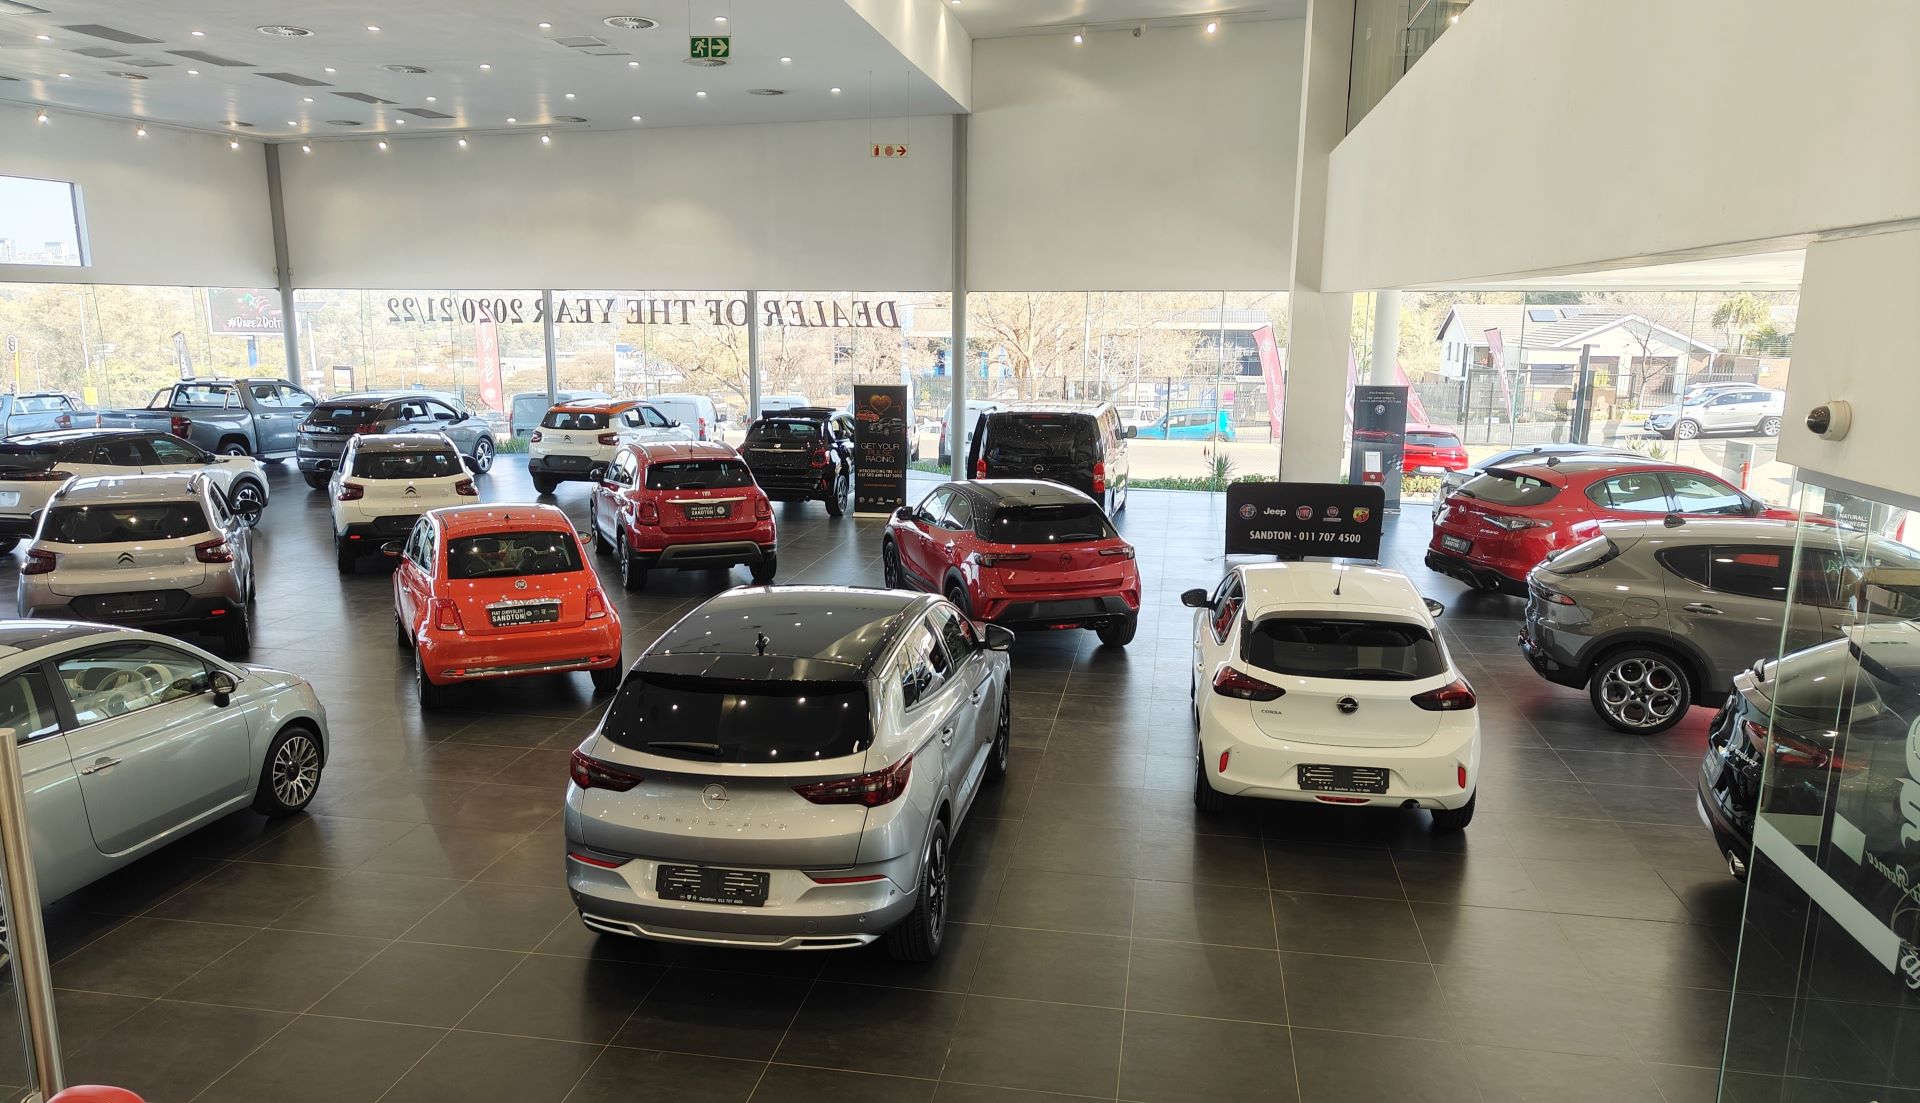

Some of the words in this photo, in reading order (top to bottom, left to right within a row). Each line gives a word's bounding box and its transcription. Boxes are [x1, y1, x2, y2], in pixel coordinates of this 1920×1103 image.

[878, 442, 900, 450] YOUR
[1263, 507, 1287, 516] Jeep
[1250, 530, 1291, 540] SANDTON
[1299, 531, 1315, 541] 011
[1318, 532, 1335, 542] 707
[1338, 533, 1361, 543] 4500
[492, 613, 525, 622] SANDTON
